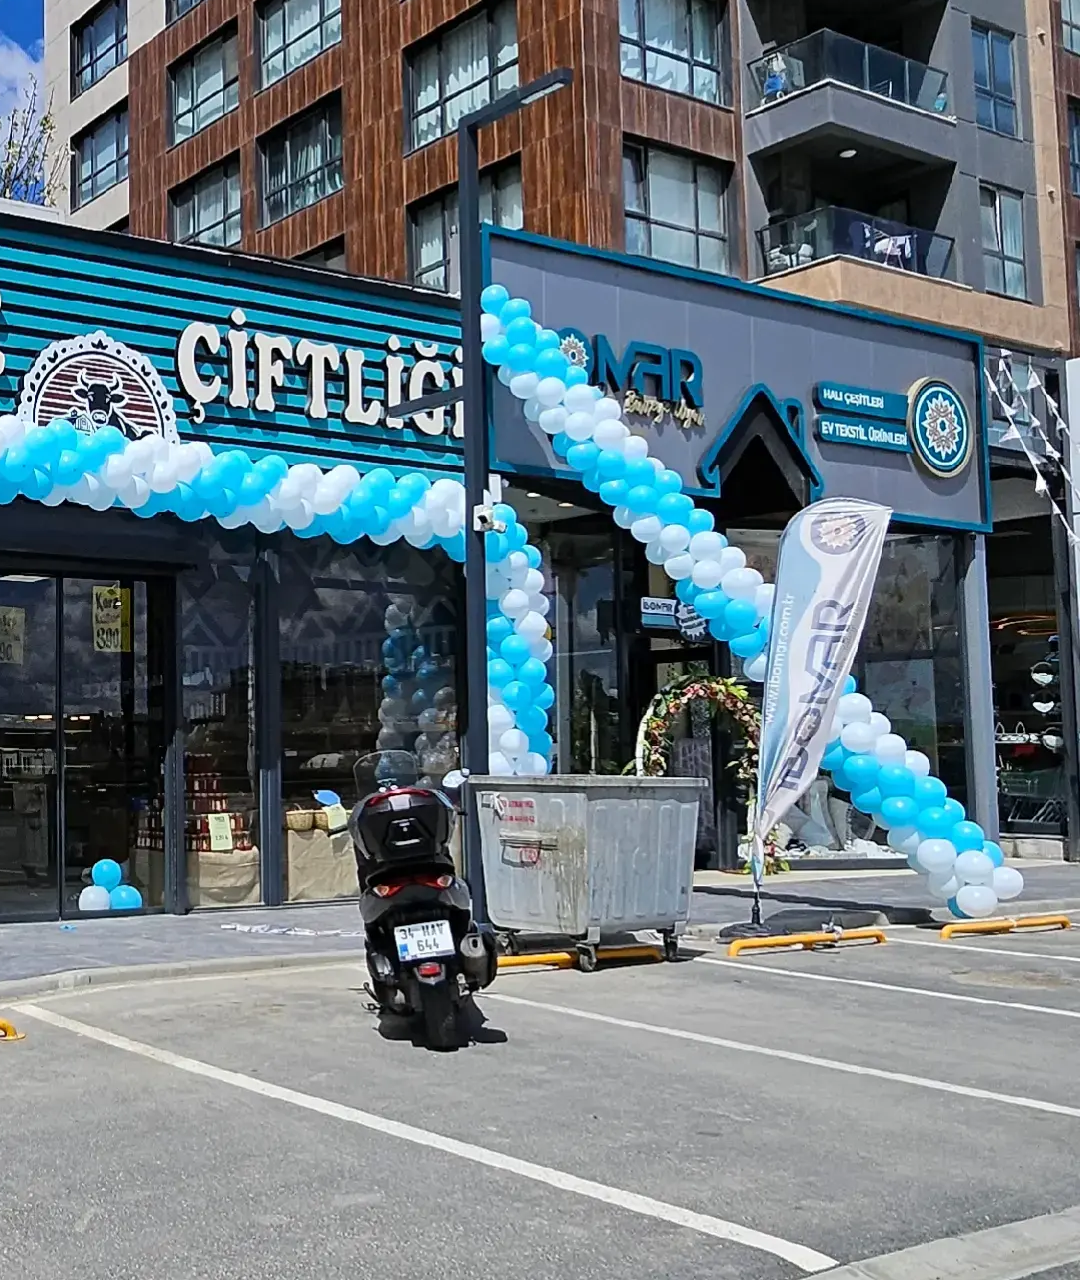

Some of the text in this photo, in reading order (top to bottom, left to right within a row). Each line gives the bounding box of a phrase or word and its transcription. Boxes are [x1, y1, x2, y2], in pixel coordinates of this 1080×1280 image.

[823, 388, 843, 402] HALI
[821, 421, 833, 435] EV
[835, 423, 867, 440] TEKSTİL
[400, 927, 414, 940] 34
[417, 938, 439, 951] 644
